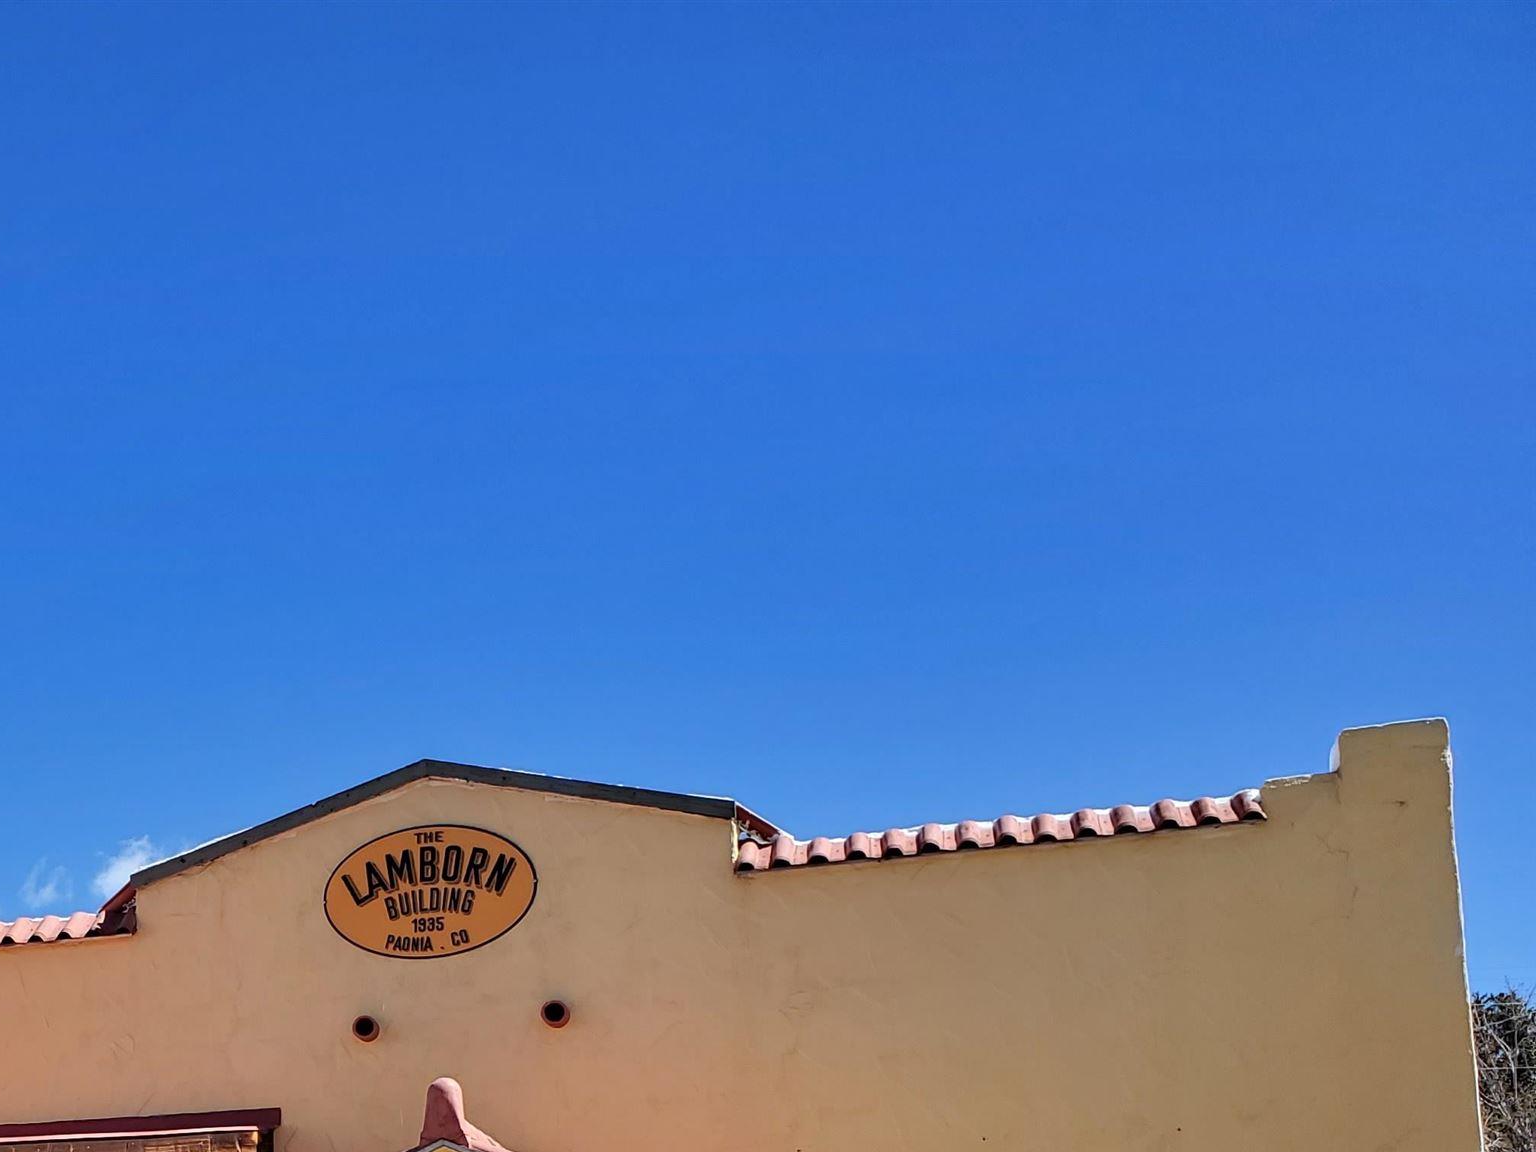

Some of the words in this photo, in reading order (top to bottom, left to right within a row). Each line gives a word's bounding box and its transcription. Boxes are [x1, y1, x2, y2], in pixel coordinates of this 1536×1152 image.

[414, 831, 444, 844] THE
[341, 845, 517, 906] LAMBORN
[384, 887, 476, 920] BUILDING
[411, 917, 444, 932] 1935
[385, 934, 434, 951] PAONIA
[450, 929, 470, 946] CO
